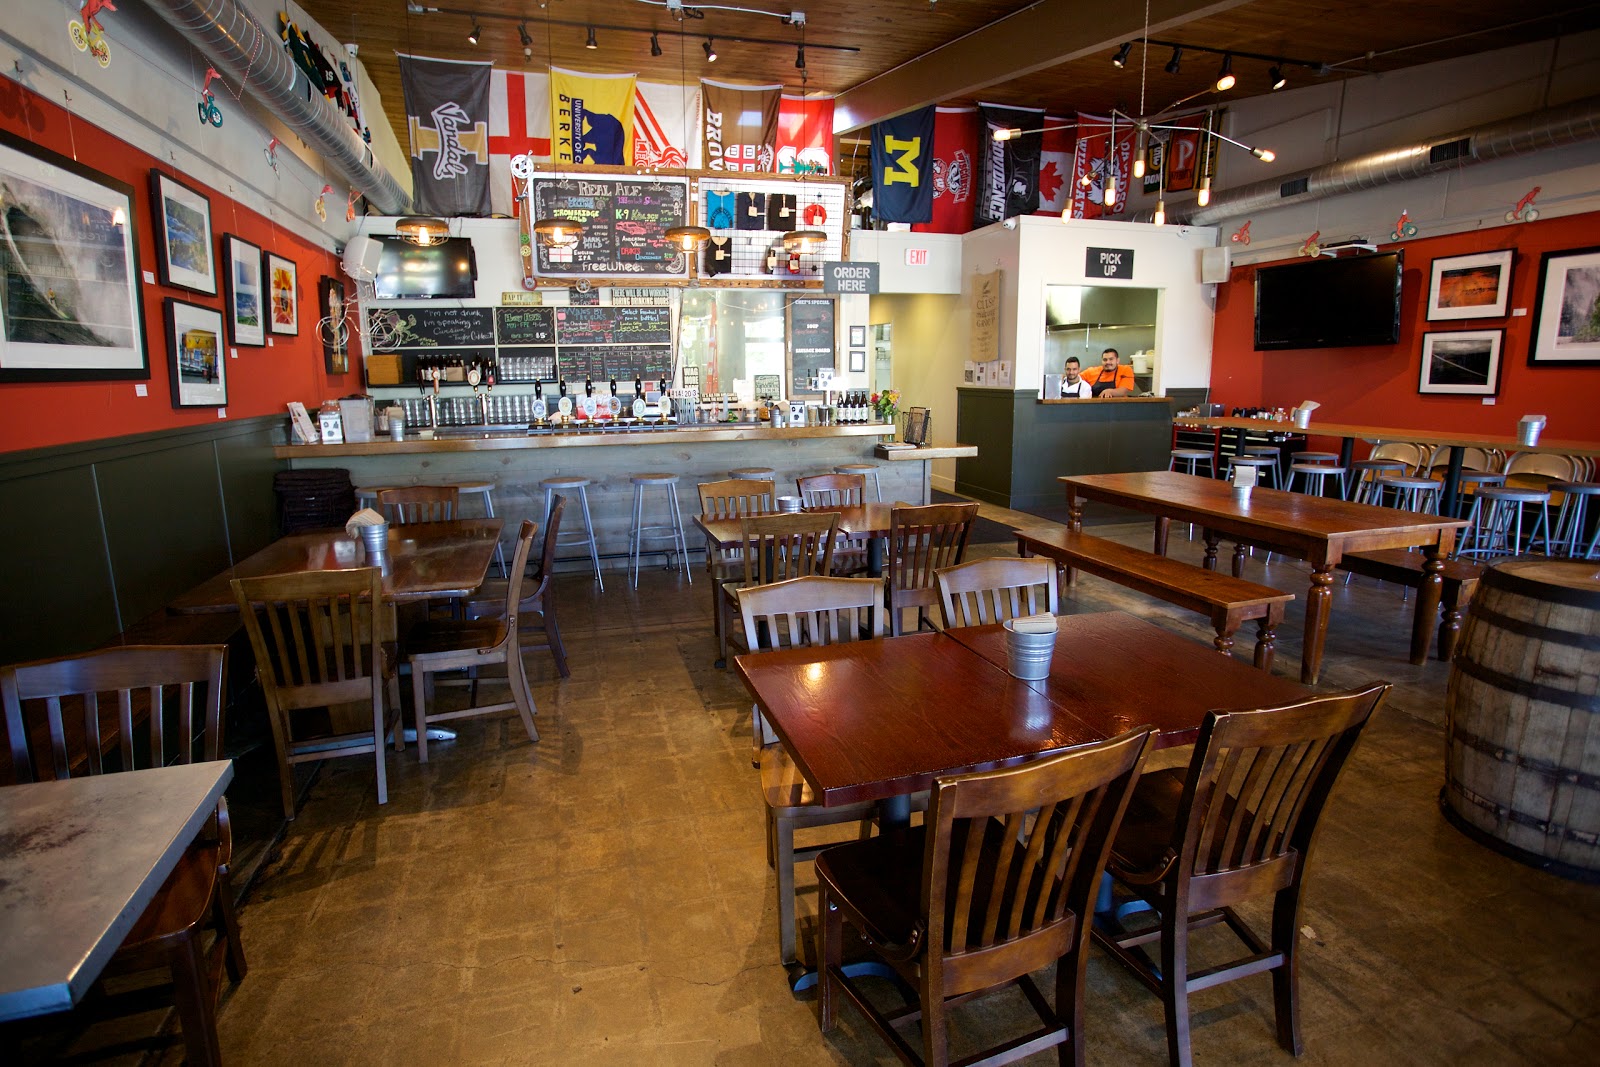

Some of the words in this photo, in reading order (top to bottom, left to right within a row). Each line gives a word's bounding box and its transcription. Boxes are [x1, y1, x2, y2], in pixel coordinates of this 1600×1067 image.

[559, 93, 571, 161] BERKE
[574, 99, 582, 141] UNIVERSITY
[431, 101, 470, 180] Vandals
[574, 142, 582, 153] OF
[574, 156, 582, 164] C
[883, 135, 920, 187] M
[1176, 139, 1194, 170] P
[956, 151, 969, 201] WISCONSIN
[1073, 138, 1088, 219] WILDCATS
[577, 181, 612, 197] REAL
[615, 182, 643, 197] ALE
[582, 236, 601, 244] DARK
[909, 250, 927, 265] EXIT
[1100, 252, 1122, 265] PICK
[833, 266, 871, 279] ORDER
[1104, 264, 1117, 277] UP
[837, 280, 866, 292] HERE
[437, 319, 471, 329] speaking
